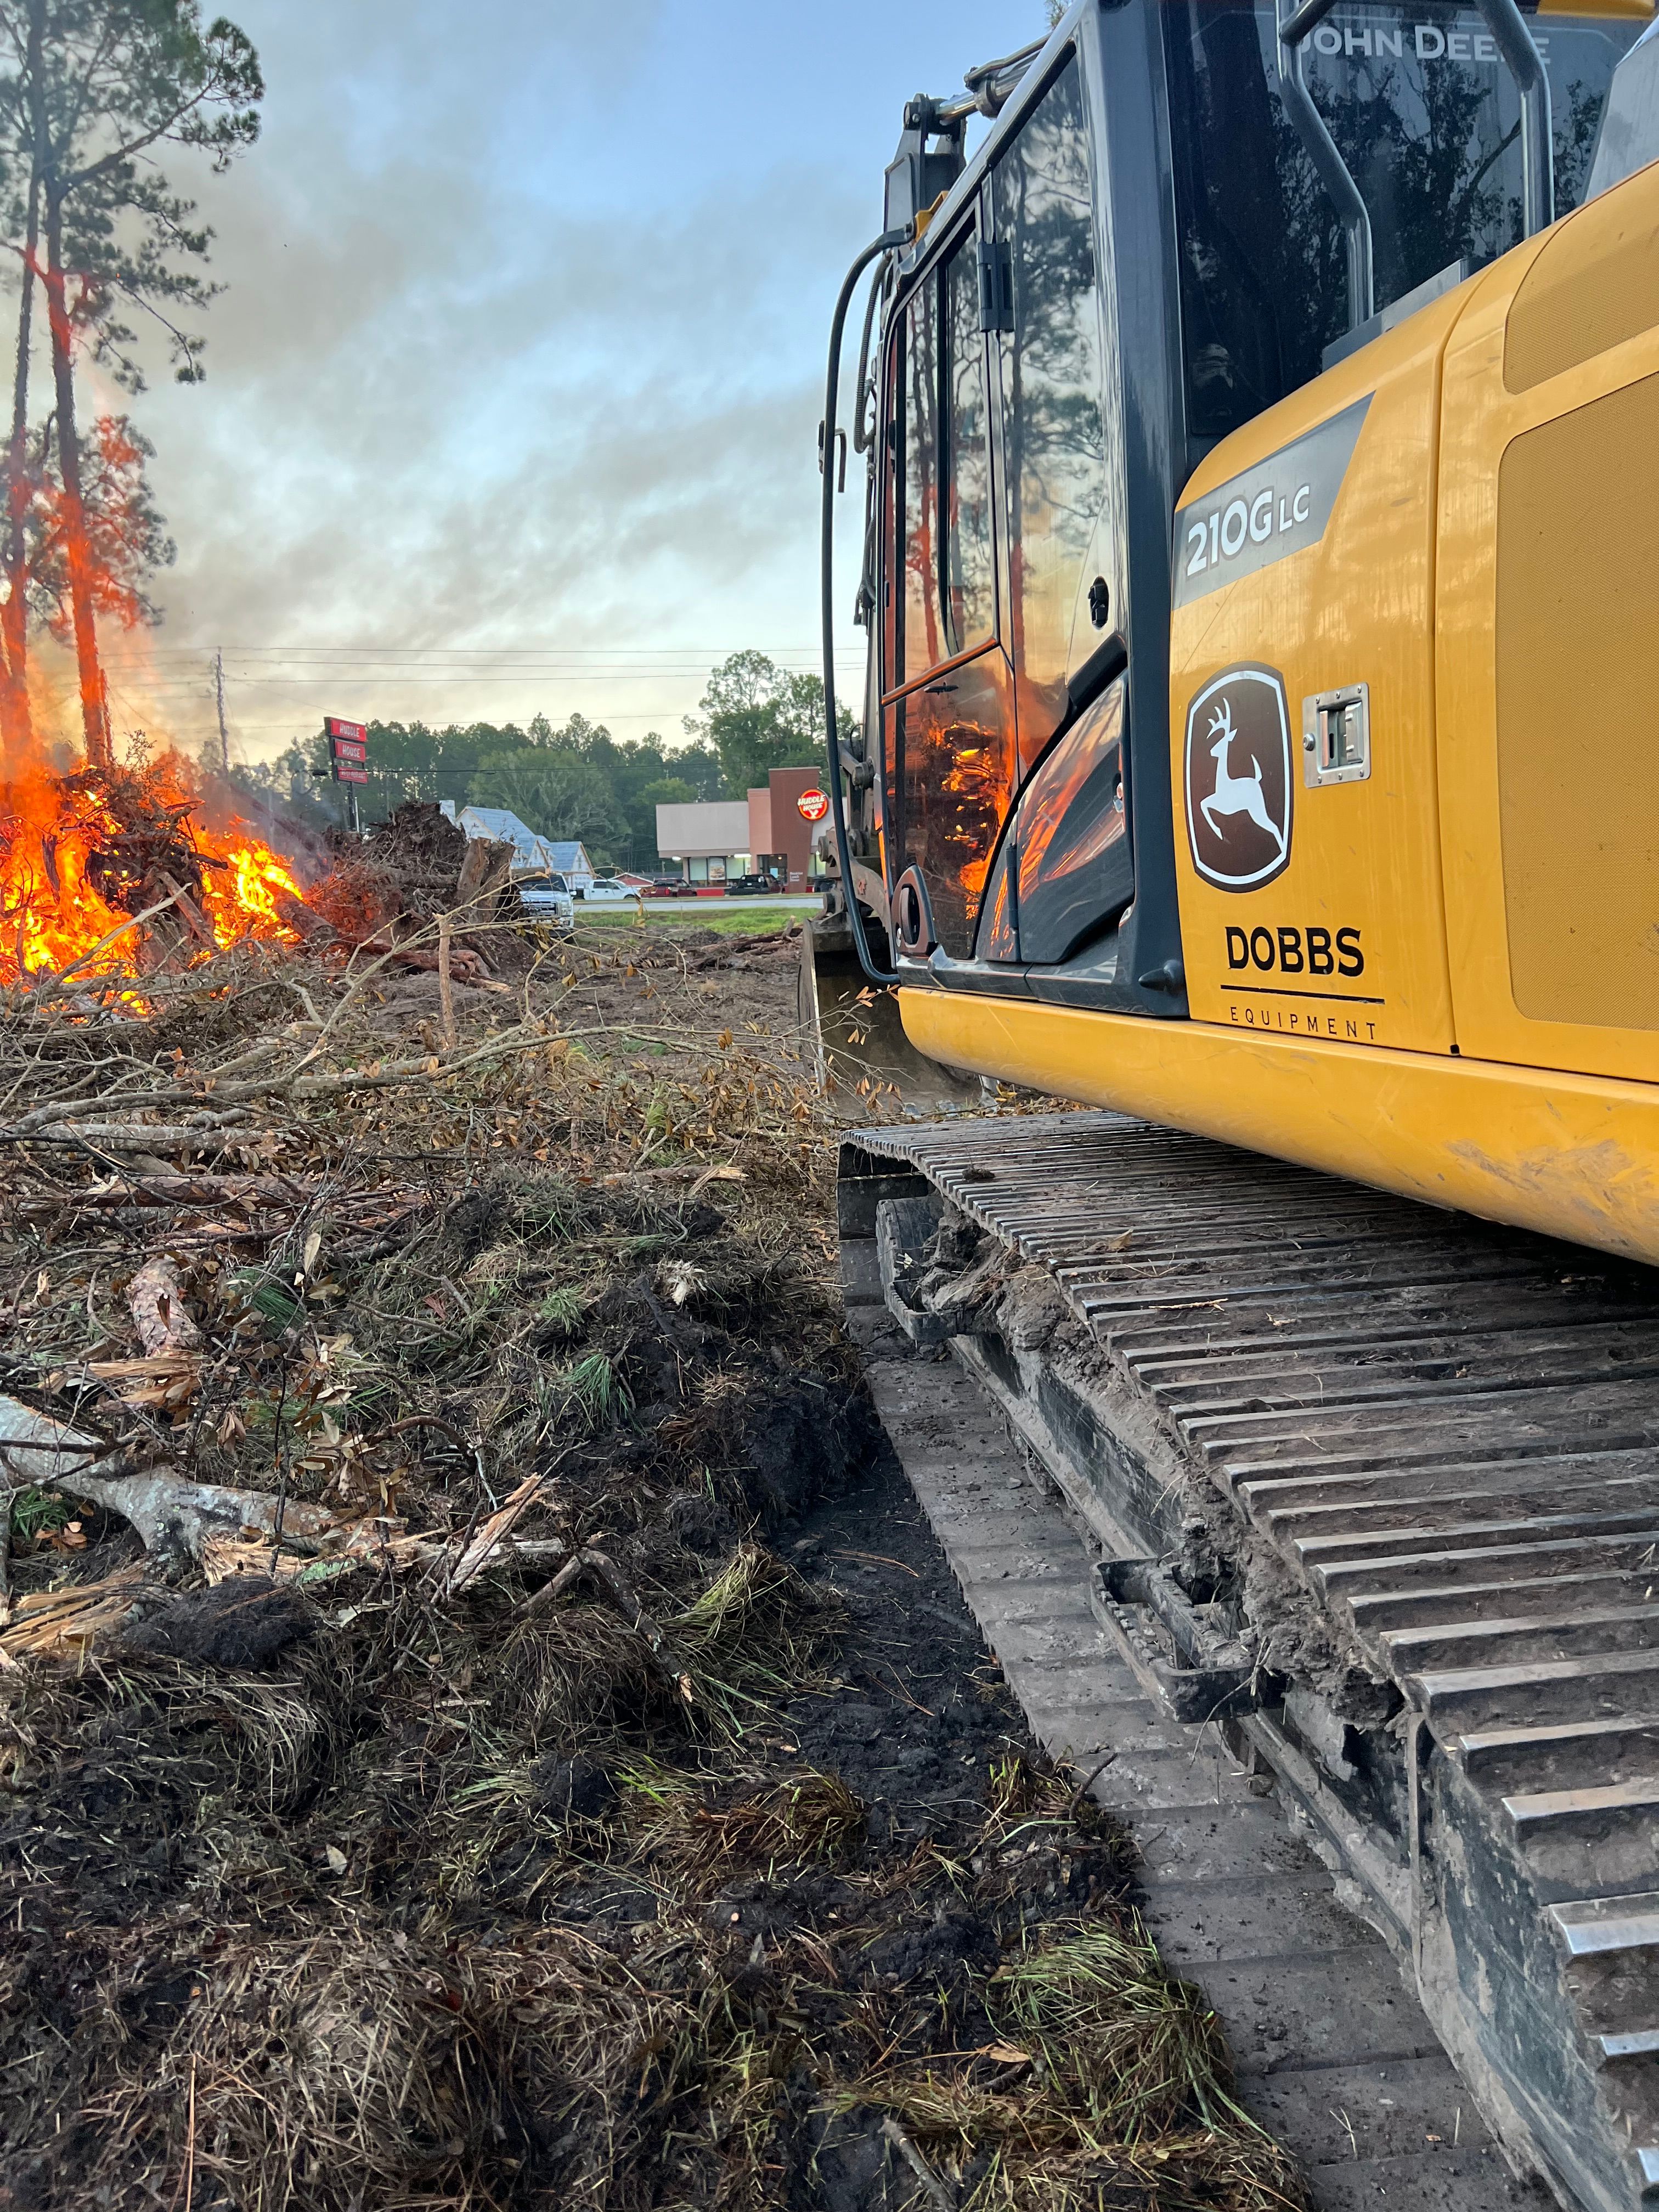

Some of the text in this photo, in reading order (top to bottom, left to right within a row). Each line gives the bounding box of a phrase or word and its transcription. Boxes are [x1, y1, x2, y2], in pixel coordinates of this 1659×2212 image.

[1415, 25, 1551, 65] DEE
[339, 723, 360, 737] HUDDLE
[342, 744, 360, 758] HOUSE
[797, 794, 826, 806] HUDDLE
[803, 802, 823, 811] HOUSE
[1224, 926, 1364, 977] DOBBS
[1229, 1006, 1375, 1040] EQUIPMENT
